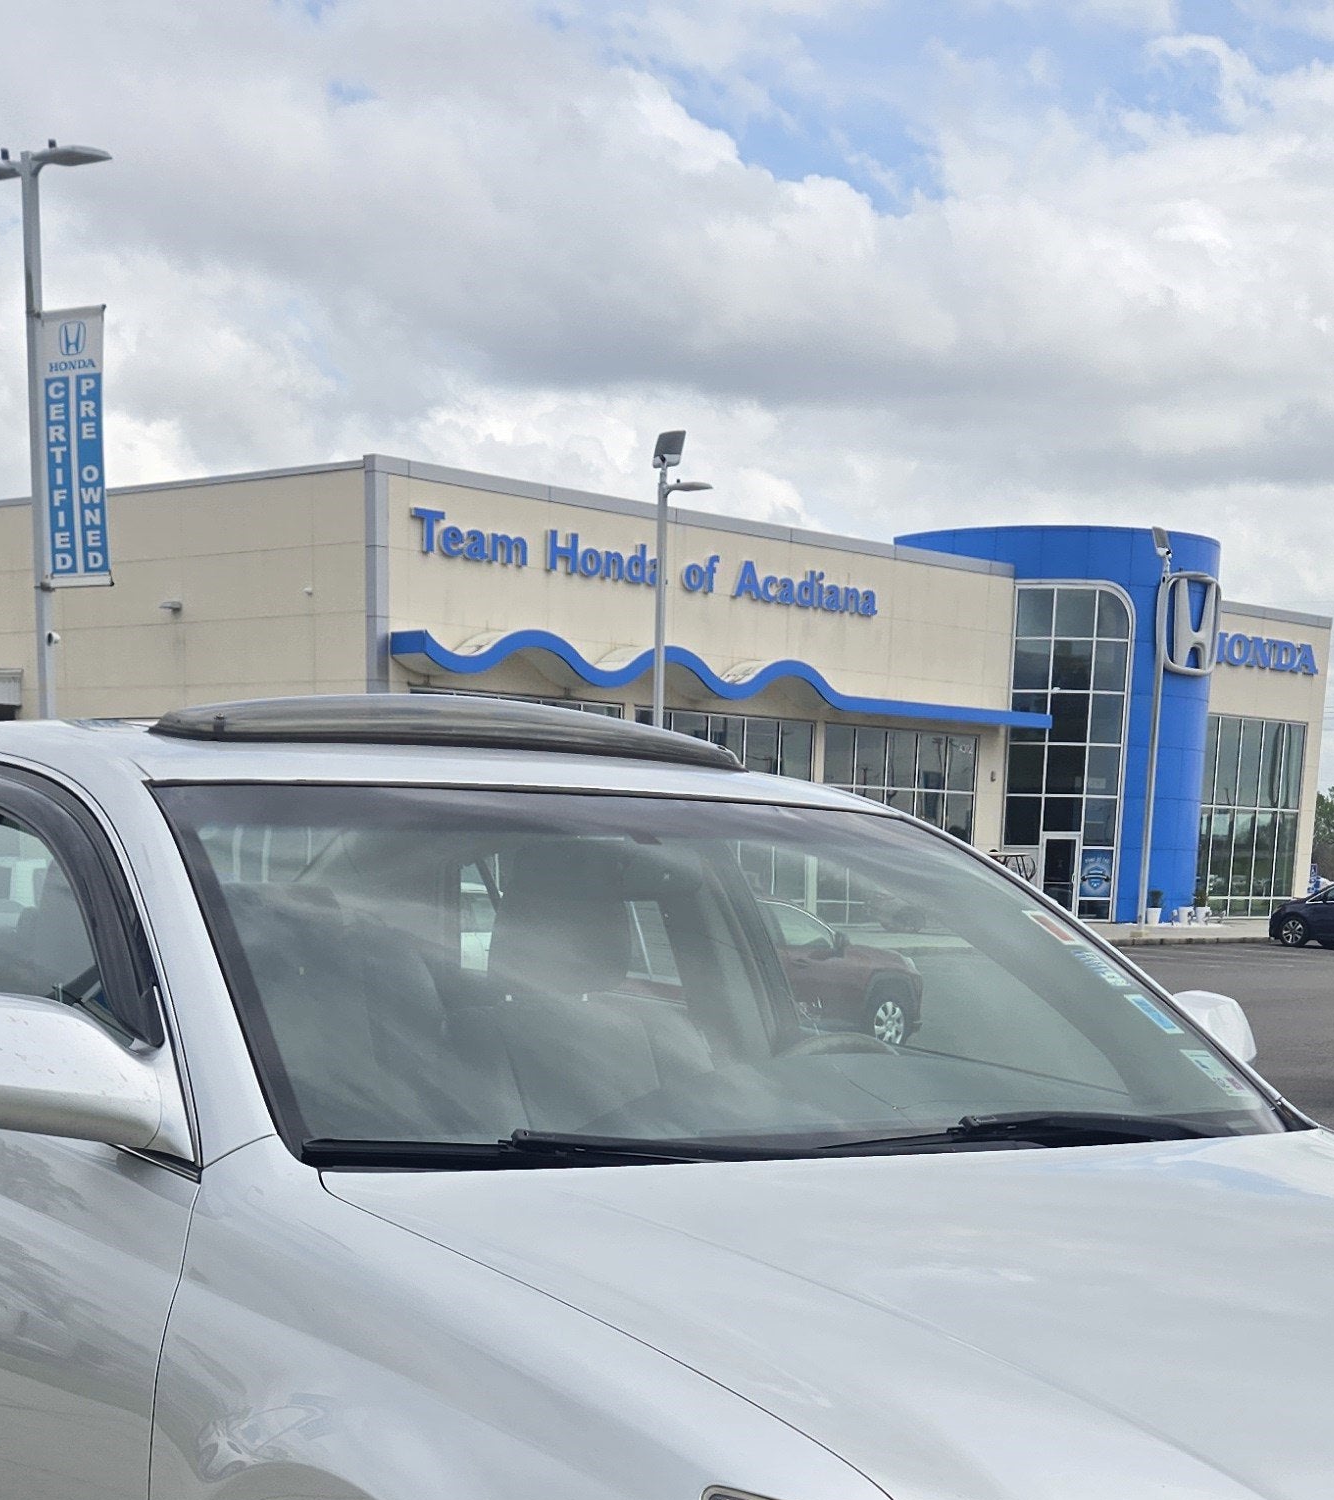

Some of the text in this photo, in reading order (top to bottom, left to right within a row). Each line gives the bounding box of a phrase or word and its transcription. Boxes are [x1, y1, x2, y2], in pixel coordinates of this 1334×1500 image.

[49, 358, 97, 373] HONDA
[48, 382, 73, 570] CERTIFIED
[80, 378, 104, 569] PRE OWNED
[410, 506, 528, 568] Team
[681, 554, 721, 594] of
[730, 559, 878, 617] Acadiana
